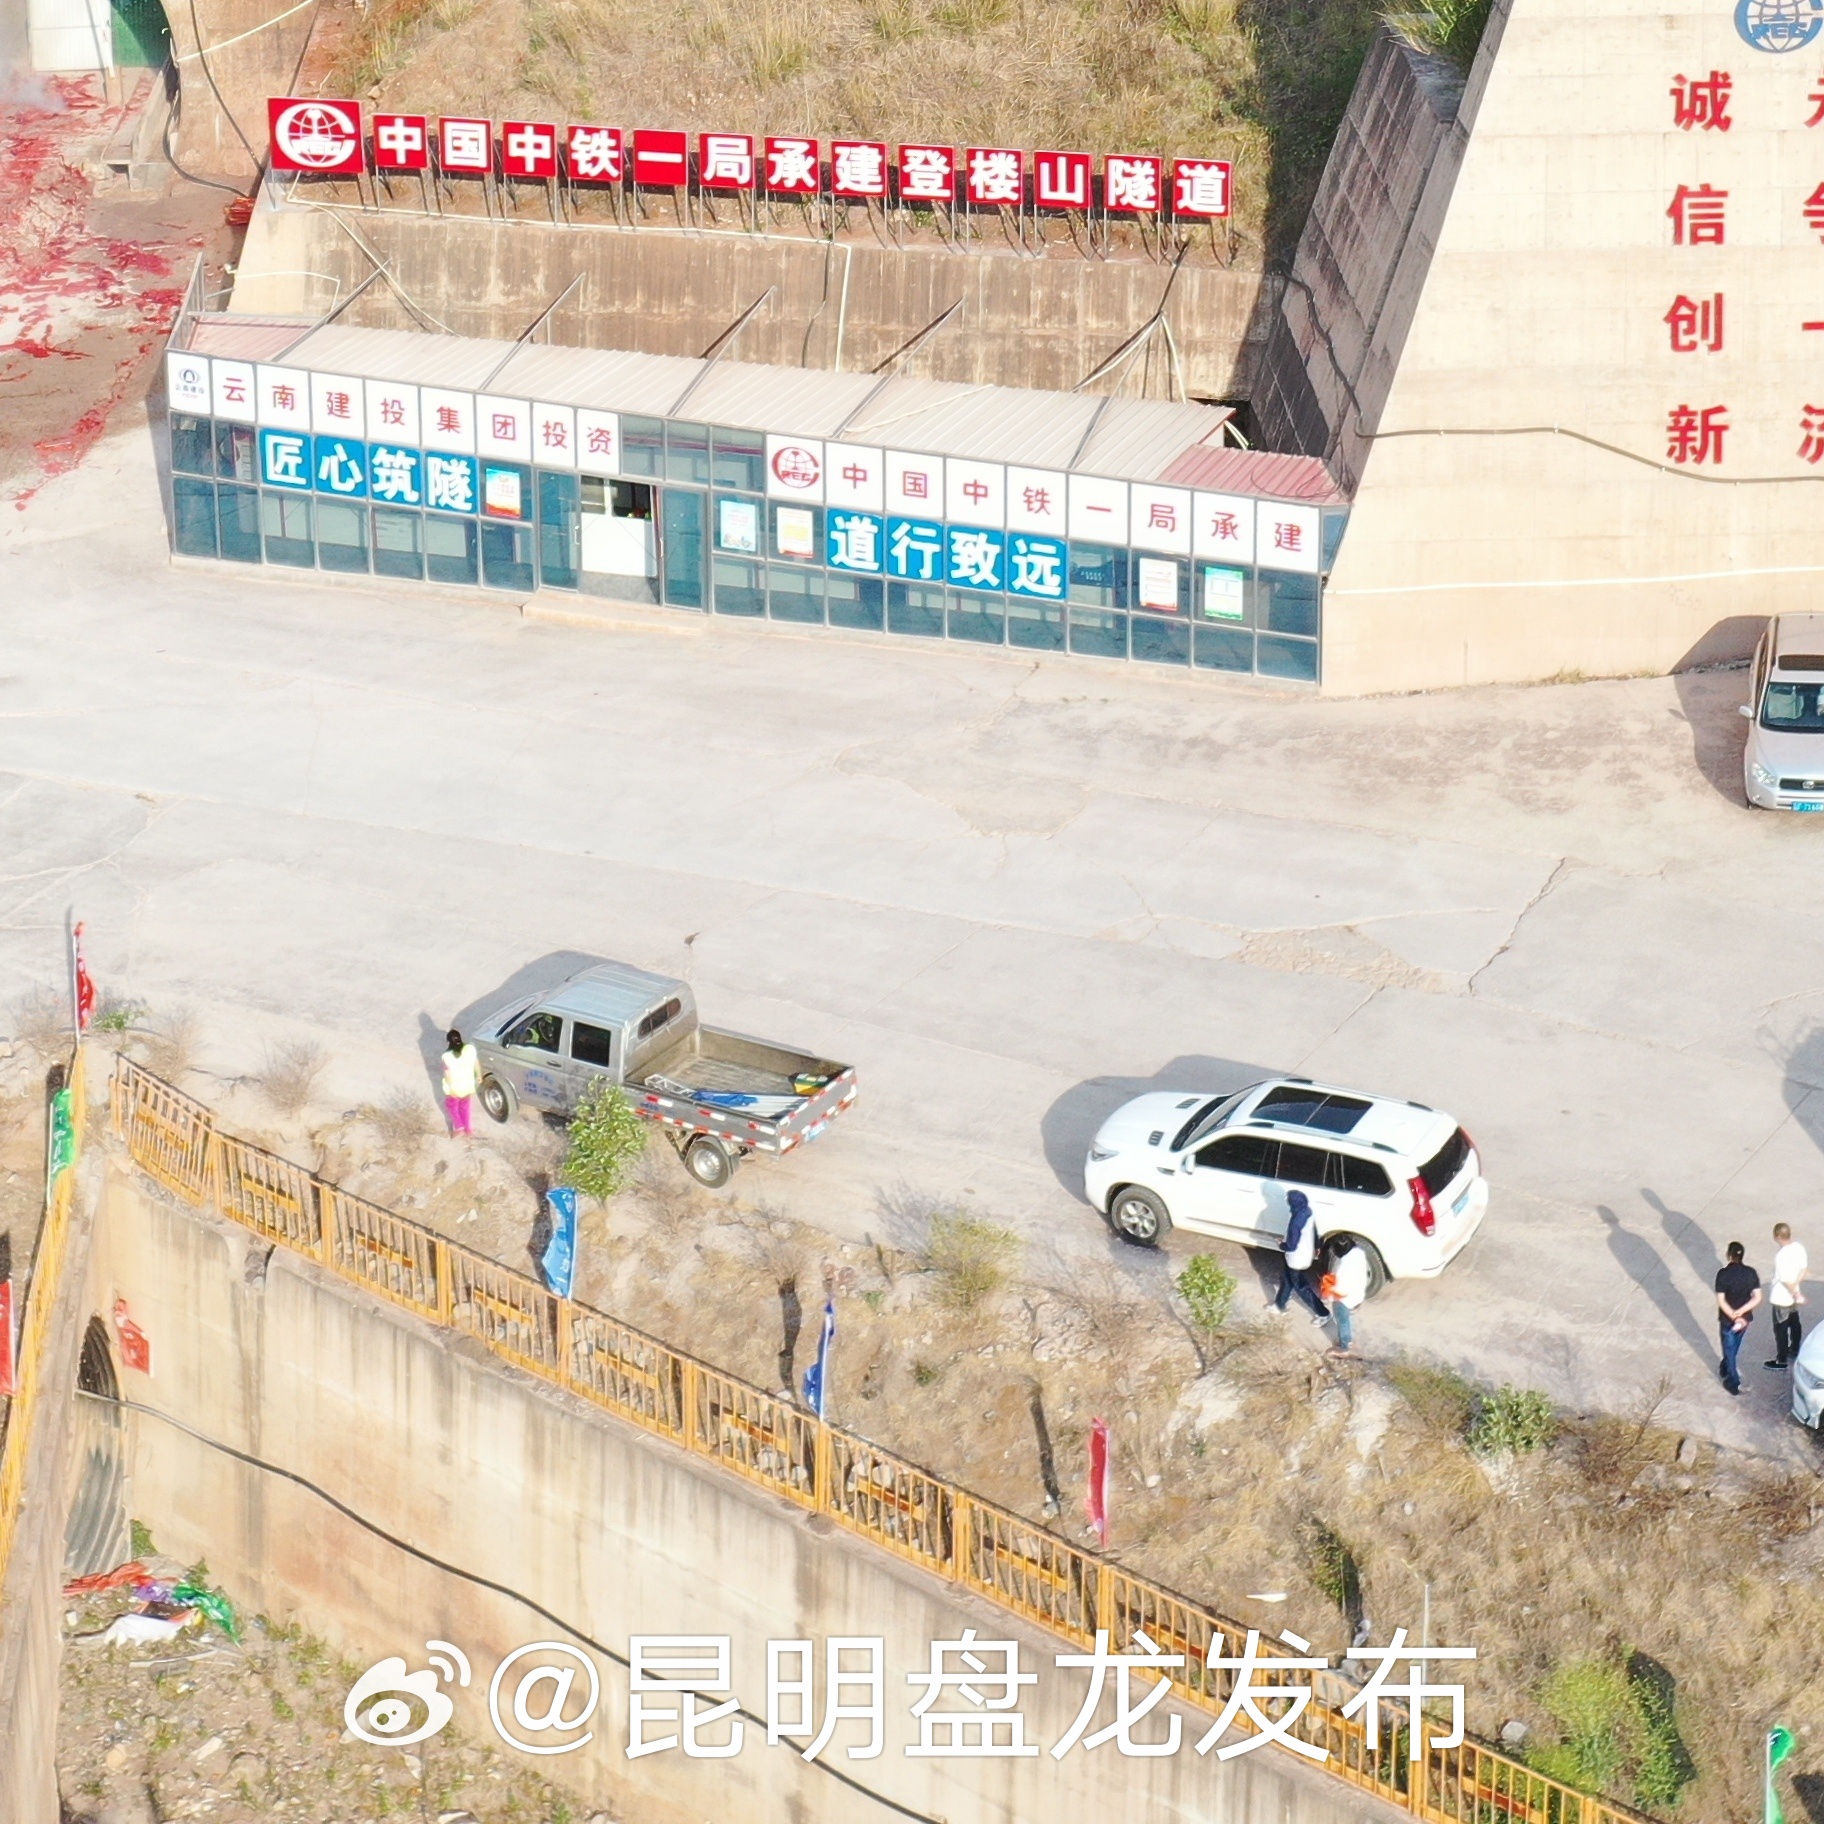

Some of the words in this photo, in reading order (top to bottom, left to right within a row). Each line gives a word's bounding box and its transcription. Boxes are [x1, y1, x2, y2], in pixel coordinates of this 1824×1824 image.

[376, 116, 1230, 216] 中国中铁一局承建登楼山隧道
[1662, 70, 1733, 465] 诚信创新
[223, 377, 612, 457] 云南建投集团投资
[263, 434, 474, 513] 匠心筑隧
[841, 461, 1303, 553] 中国中铁一局承建
[831, 513, 1062, 597] 道行致远
